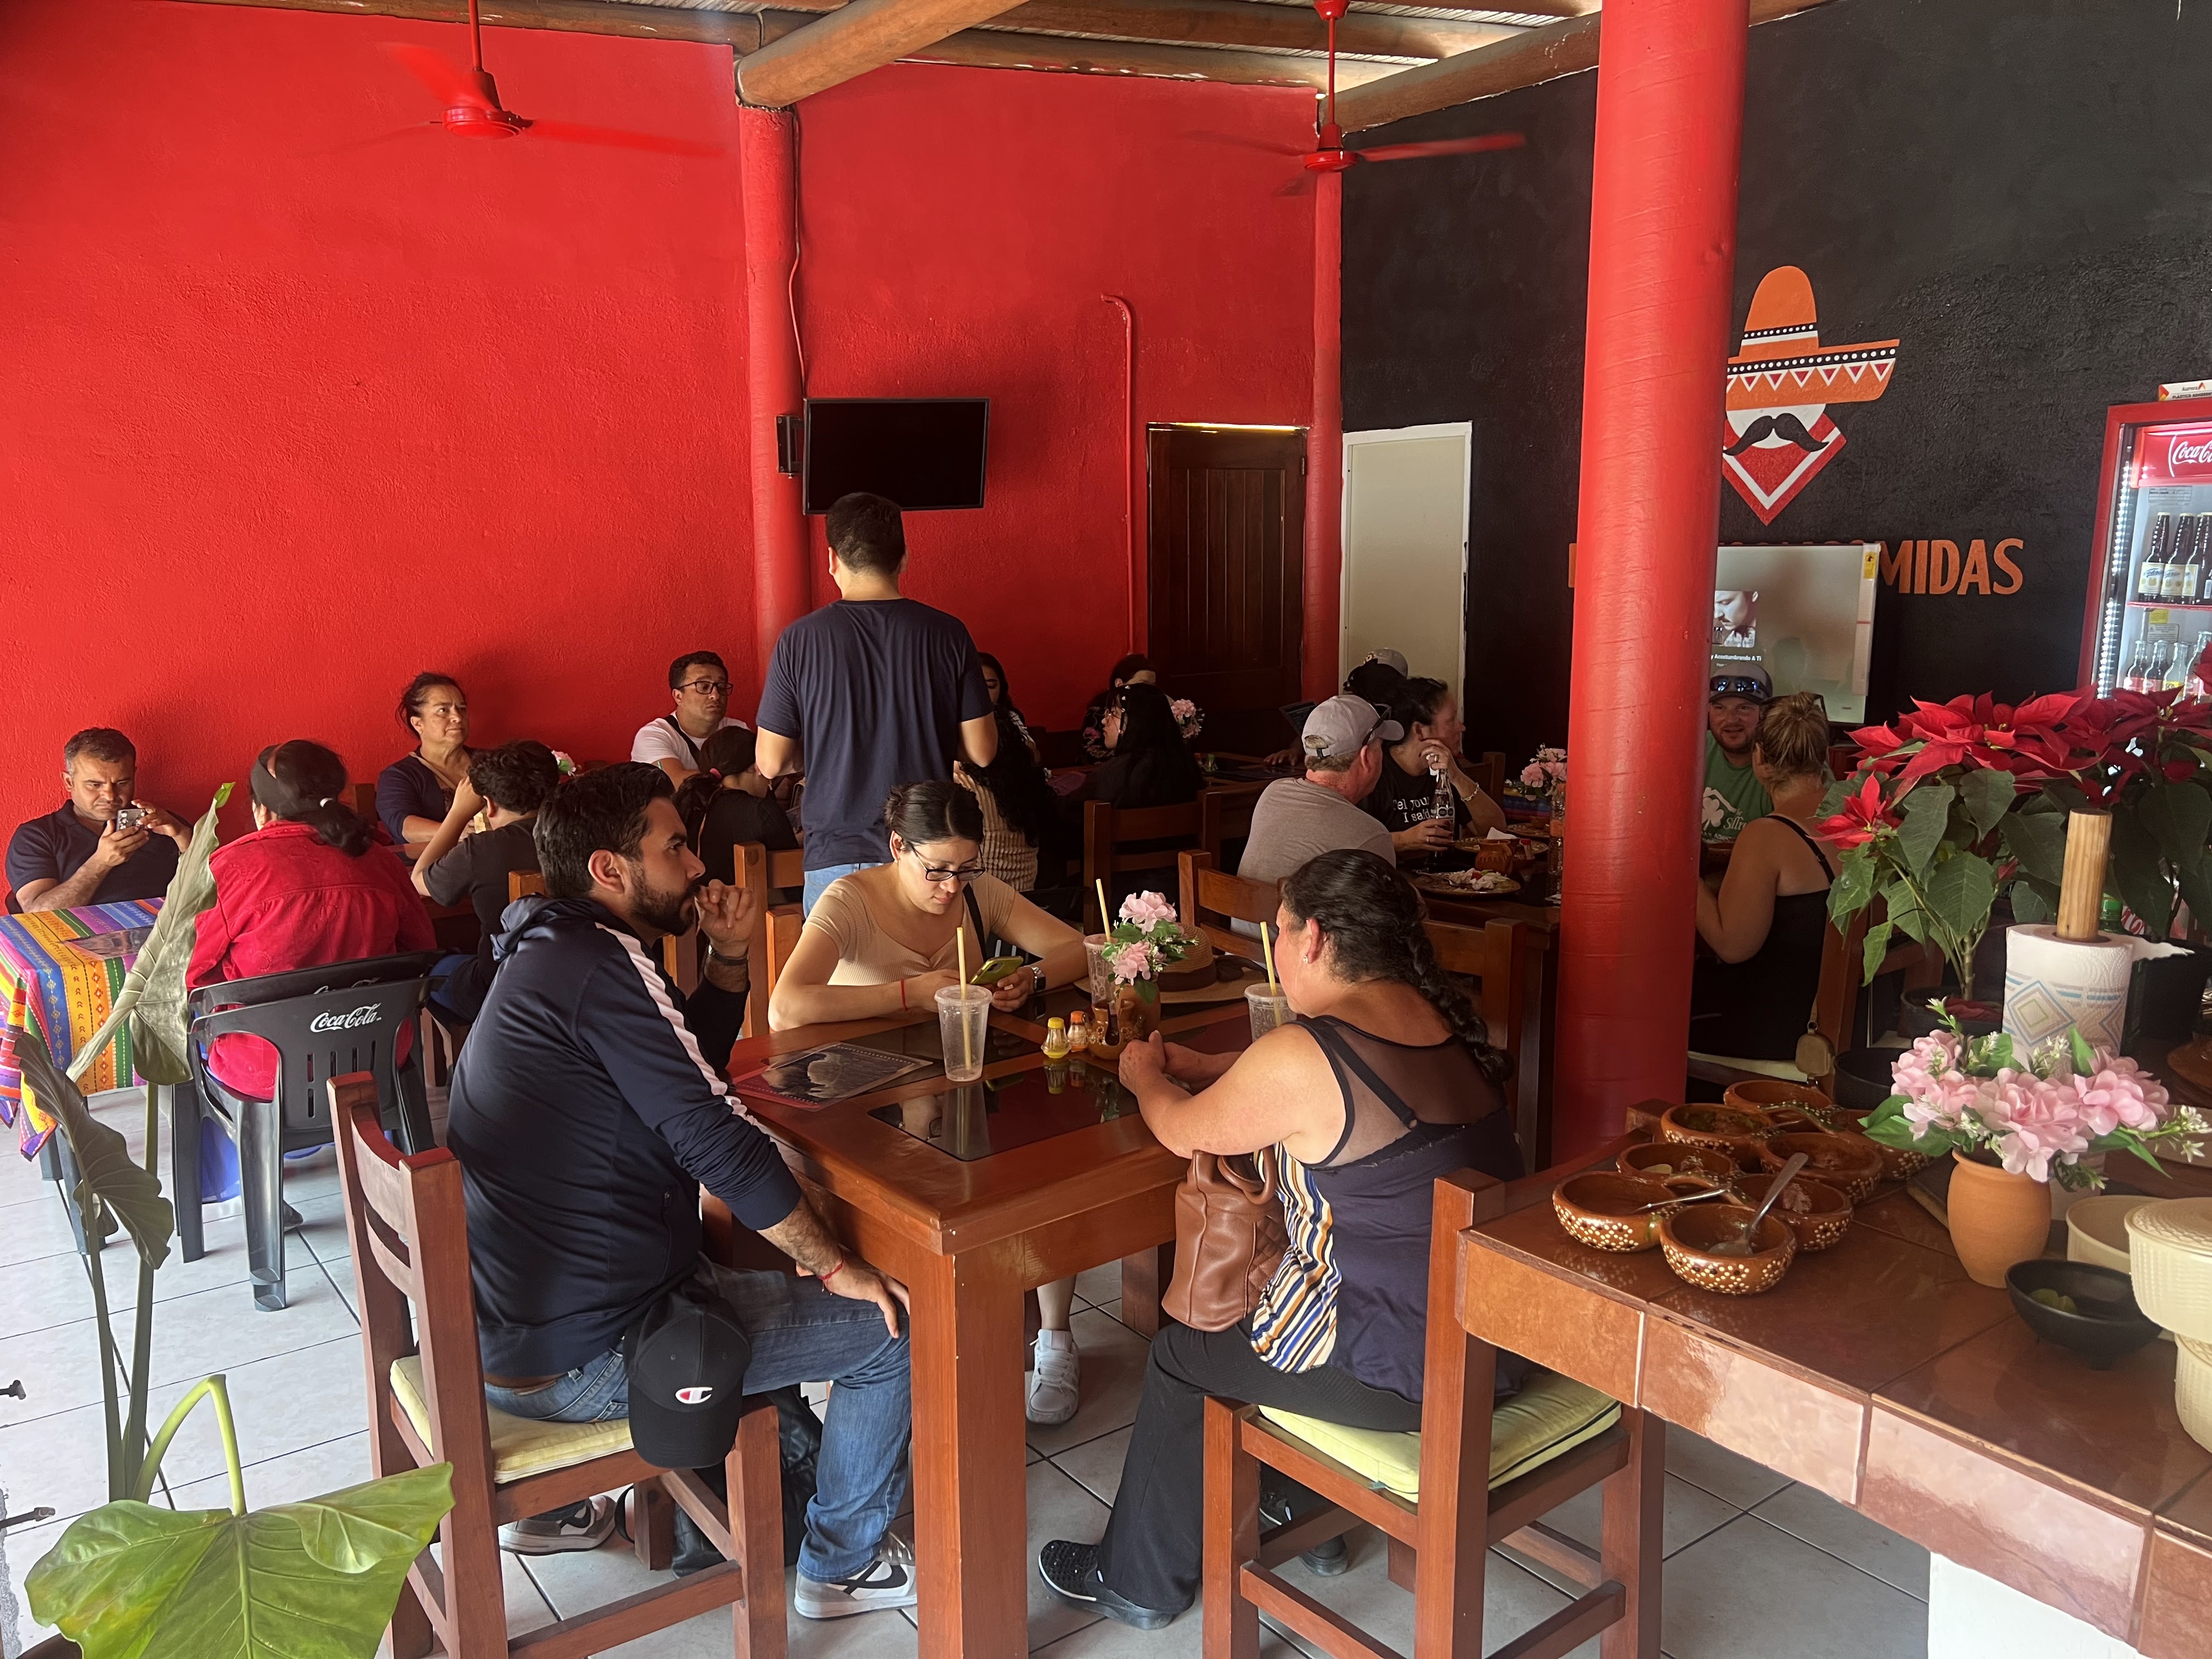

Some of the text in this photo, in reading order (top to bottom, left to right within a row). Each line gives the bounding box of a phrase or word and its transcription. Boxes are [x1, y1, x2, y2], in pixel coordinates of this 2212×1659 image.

[1824, 538, 2024, 595] MIDAS
[1403, 812, 1409, 823] I
[1411, 808, 1431, 821] said
[310, 1002, 382, 1032] Coca-Cola
